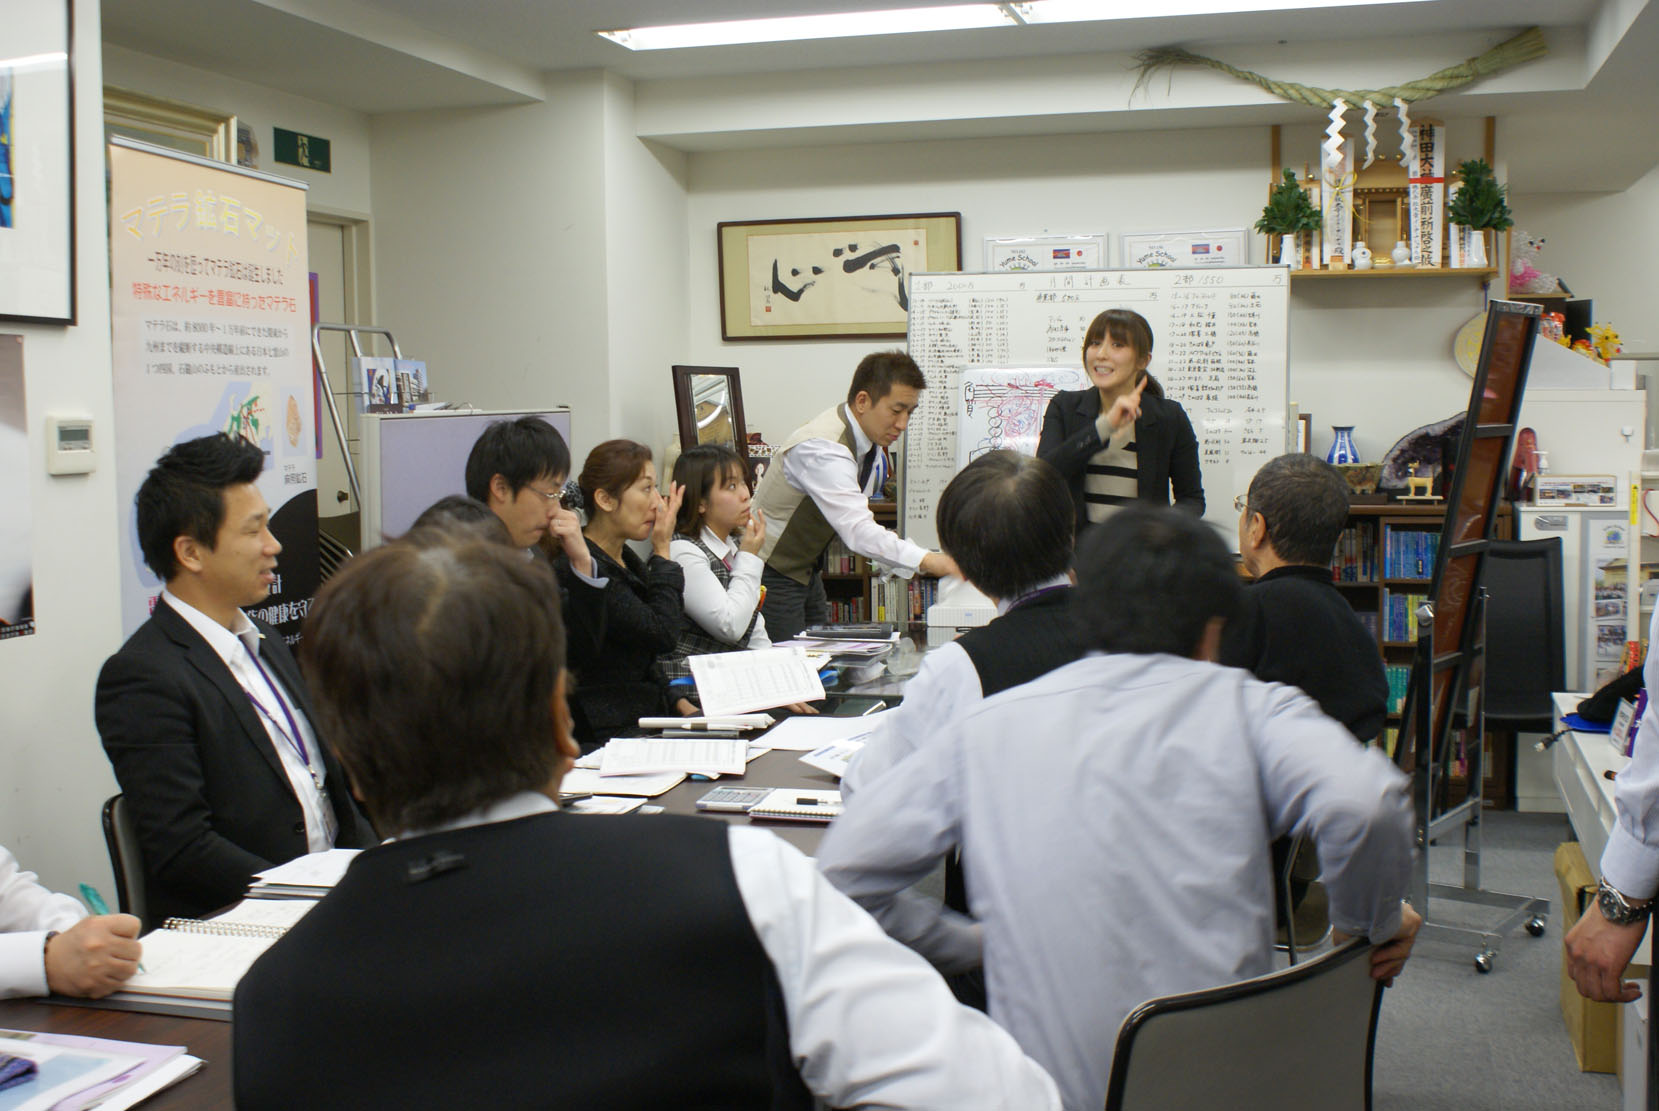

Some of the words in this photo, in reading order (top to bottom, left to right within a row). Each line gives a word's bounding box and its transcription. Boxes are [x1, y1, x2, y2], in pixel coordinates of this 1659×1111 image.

[120, 190, 298, 265] マテラ鉱石マット
[1017, 254, 1039, 267] School
[1155, 251, 1177, 263] School
[1173, 274, 1194, 285] 2部
